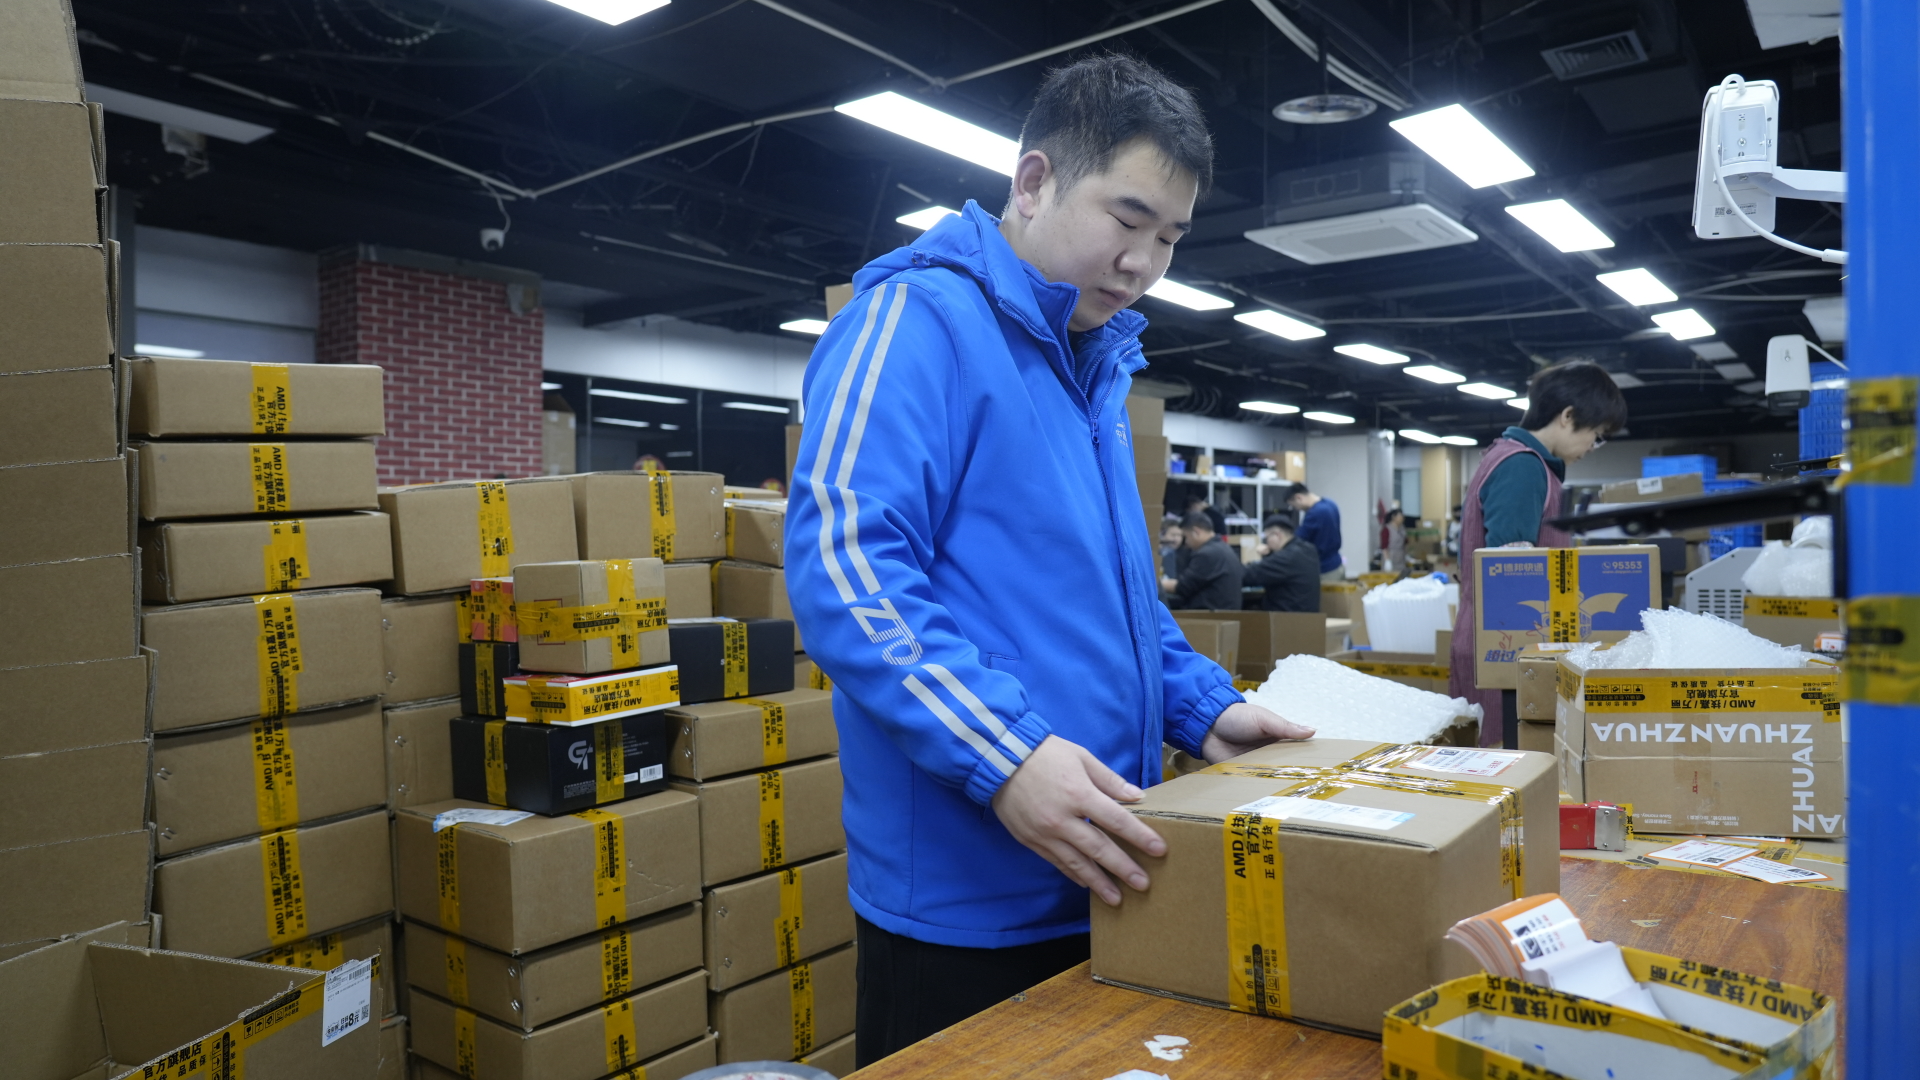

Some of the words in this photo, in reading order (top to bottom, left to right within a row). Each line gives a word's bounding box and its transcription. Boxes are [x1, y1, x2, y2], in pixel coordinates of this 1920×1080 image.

[276, 386, 286, 410] AMD
[272, 447, 282, 471] AMD
[481, 484, 490, 504] AMD
[284, 606, 296, 639] 品质保证
[849, 598, 923, 665] ZTO
[275, 621, 290, 669] 官方旗舰店
[1484, 648, 1517, 662] 超过
[582, 685, 609, 695] 品质保证
[594, 689, 631, 700] 官方旗舰店
[1686, 690, 1739, 699] 官方旗舰店
[624, 697, 642, 707] AMD
[1671, 699, 1692, 708] 万丽
[1700, 699, 1722, 709] 技嘉
[1730, 699, 1756, 708] AMD
[264, 767, 274, 790] AMD
[1232, 815, 1247, 828] 技
[1247, 813, 1262, 855] 官方旗
[1232, 840, 1247, 878] AMD
[1263, 825, 1275, 879] 正品行货
[276, 912, 286, 935] AMD
[1649, 965, 1688, 987] 万丽
[1467, 991, 1499, 1010] 万丽
[1704, 979, 1745, 1004] 技嘉
[1511, 996, 1548, 1019] 技嘉
[1564, 1006, 1613, 1027] AMD
[1763, 995, 1812, 1021] AMD
[142, 1041, 203, 1080] 官方旗舰店
[178, 1054, 207, 1078] 品质保
